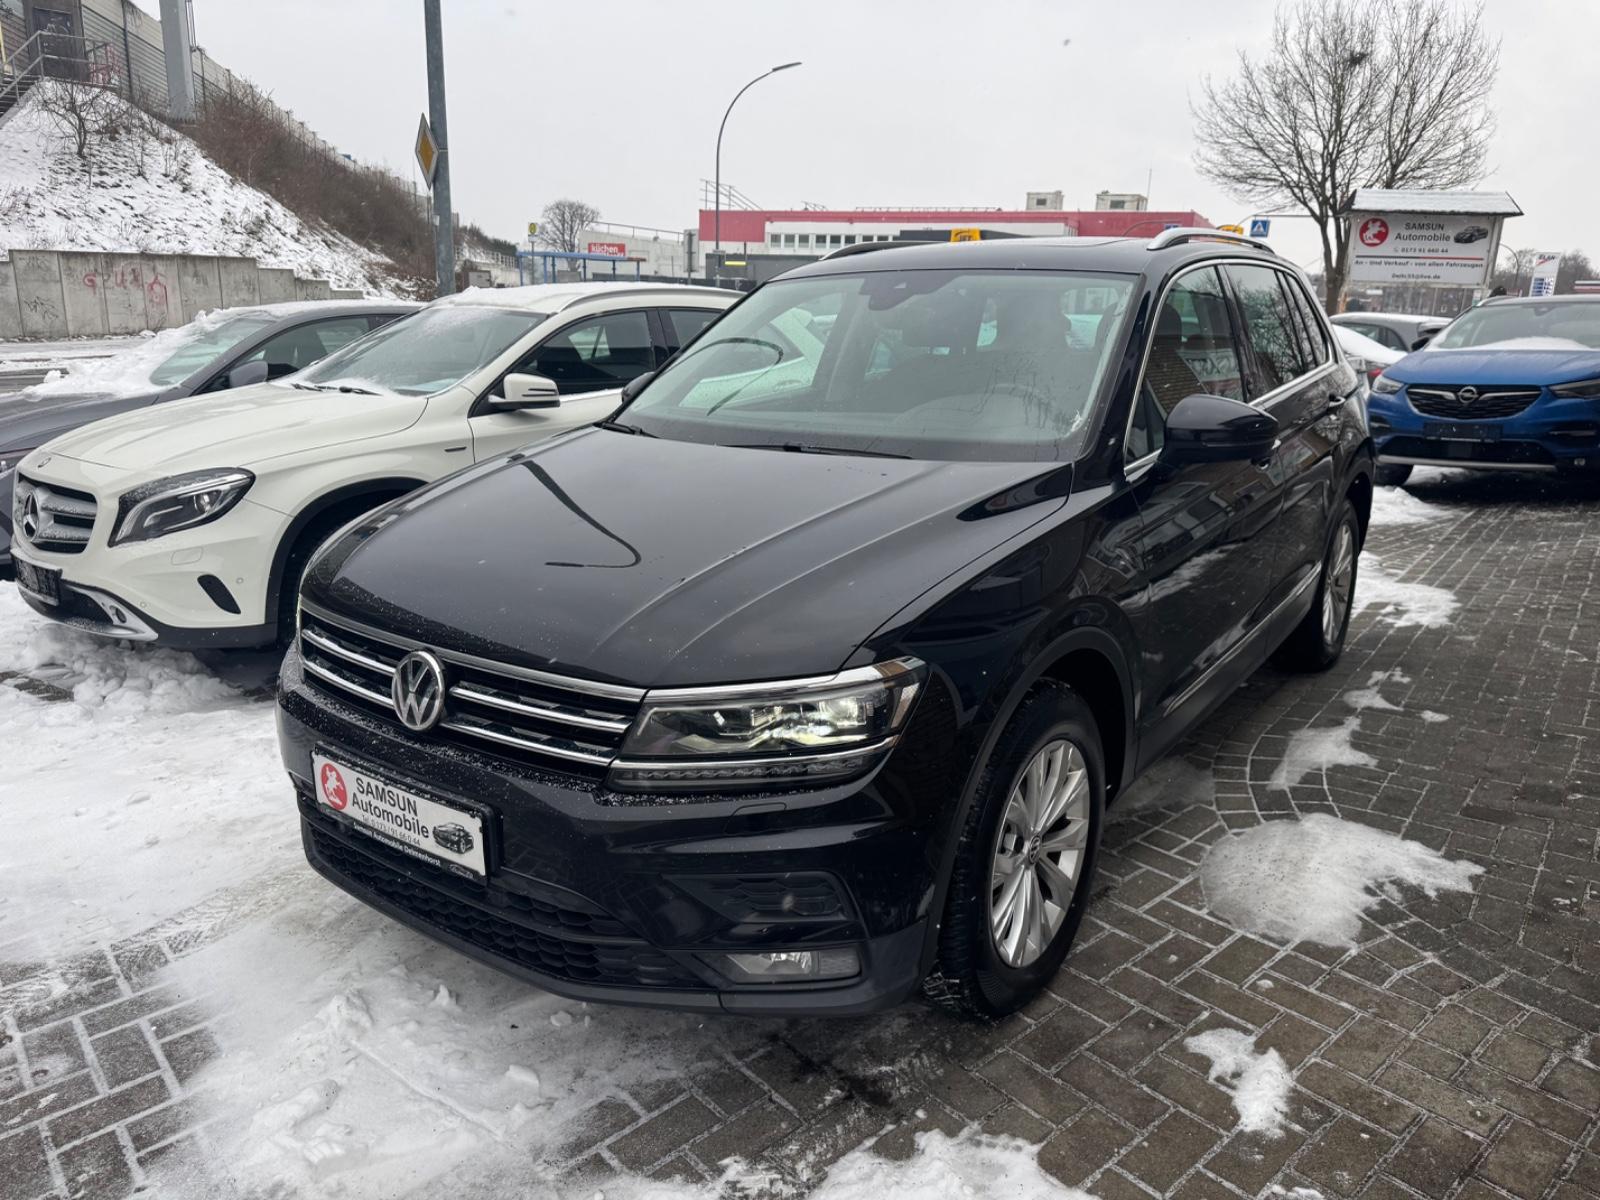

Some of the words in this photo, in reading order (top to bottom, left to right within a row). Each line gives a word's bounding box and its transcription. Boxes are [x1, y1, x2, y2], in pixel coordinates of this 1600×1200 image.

[1394, 232, 1451, 242] Automobile
[1404, 222, 1445, 231] SAMSUN
[355, 777, 418, 817] SAMSUN
[352, 792, 430, 839] Automobile
